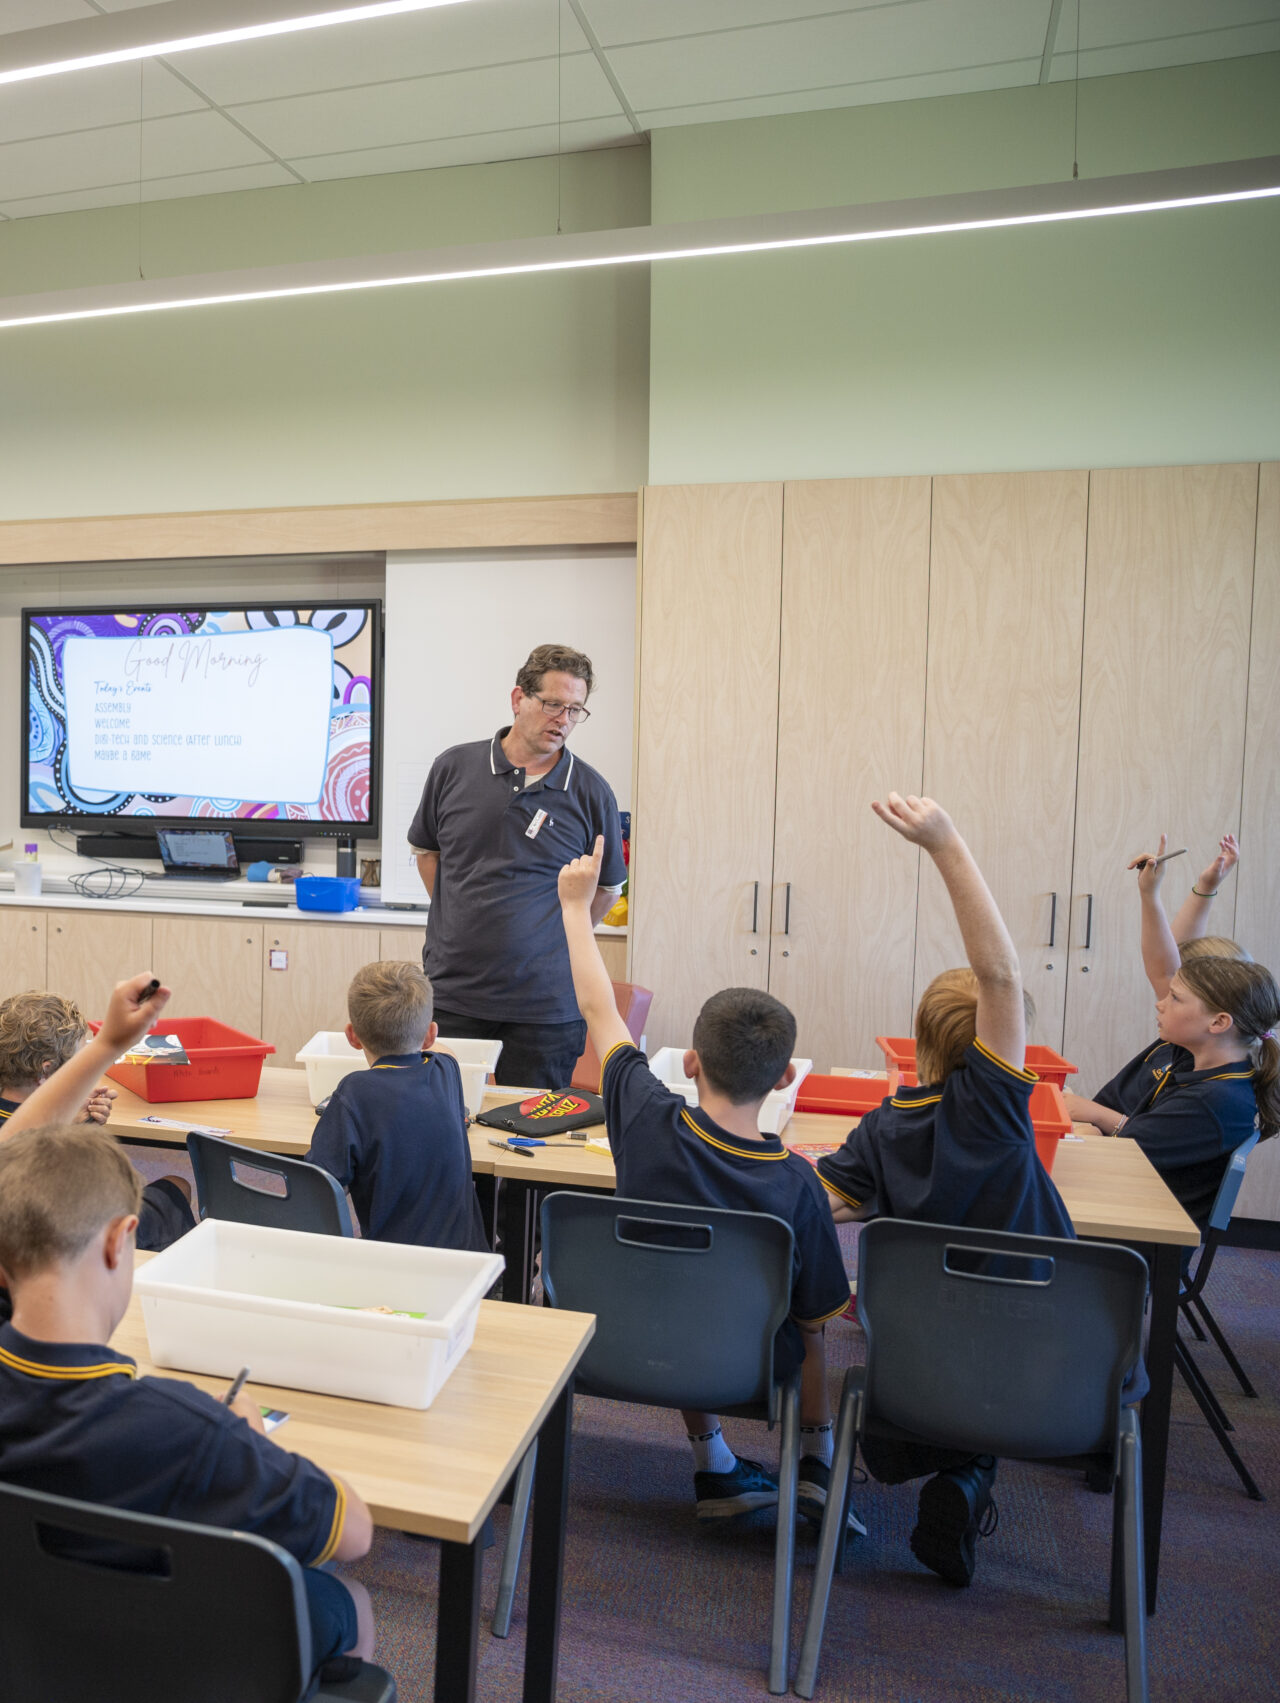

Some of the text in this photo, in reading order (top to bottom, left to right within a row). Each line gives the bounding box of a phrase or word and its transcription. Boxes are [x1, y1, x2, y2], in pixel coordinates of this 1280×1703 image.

[124, 638, 268, 688] Good Morning
[93, 679, 153, 697] Today's Events
[94, 702, 132, 713] ASSEMBLY
[94, 718, 131, 729] WELCOME
[151, 734, 183, 746] SCIENCE
[94, 750, 120, 761] MAYBE
[131, 750, 152, 761] GAME
